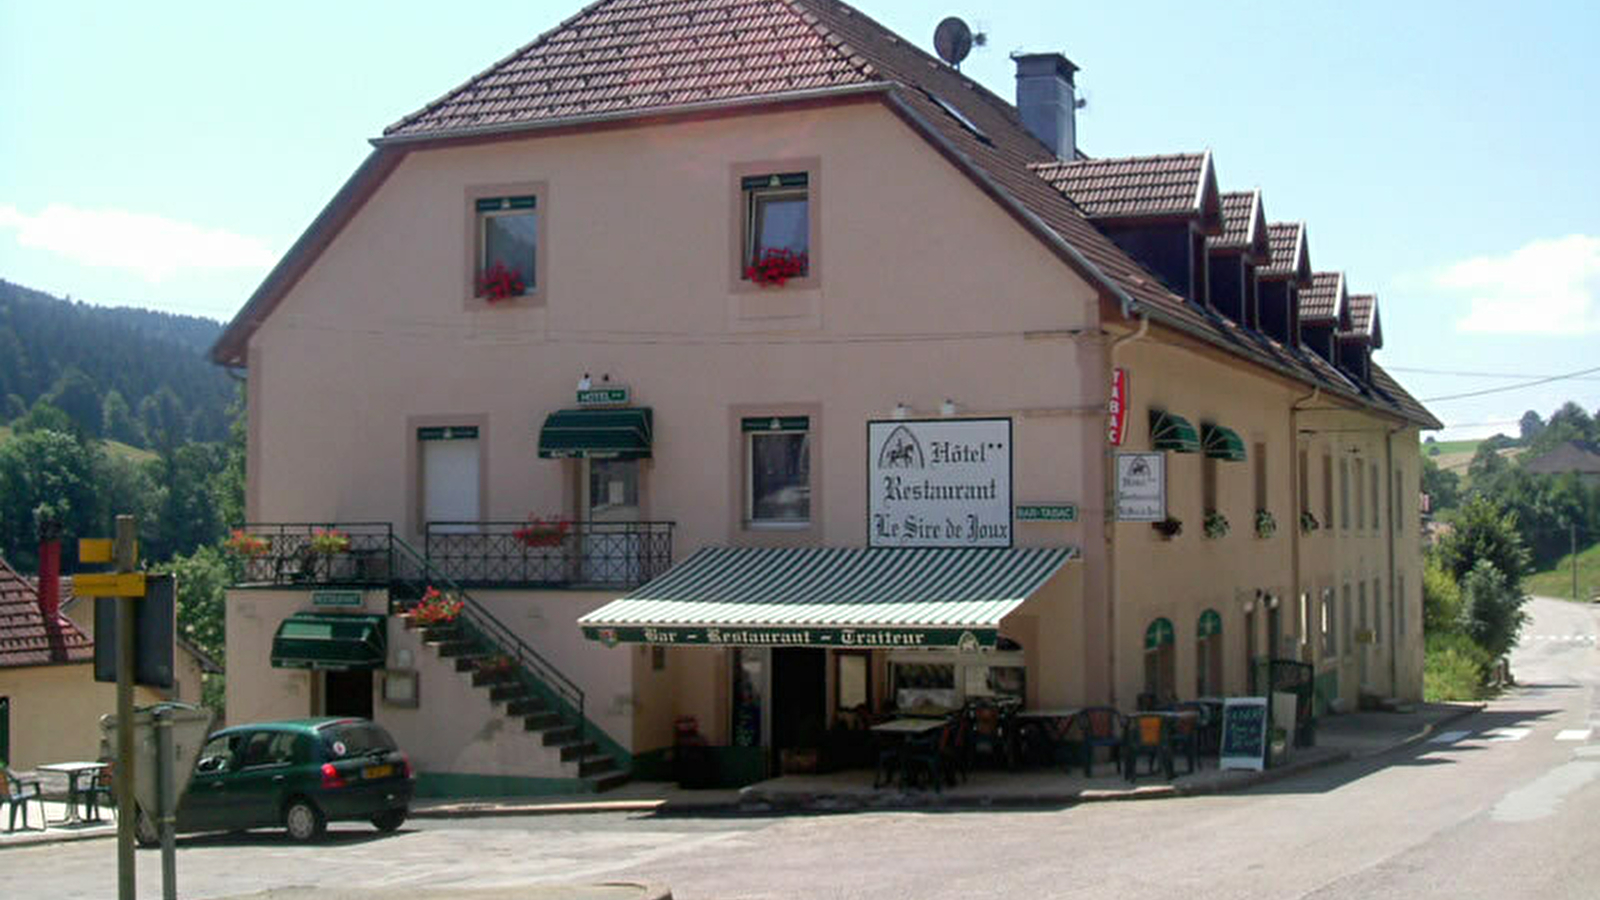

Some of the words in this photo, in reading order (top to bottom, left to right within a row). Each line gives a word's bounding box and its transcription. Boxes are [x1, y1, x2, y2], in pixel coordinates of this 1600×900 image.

[1109, 371, 1121, 443] TABAC
[931, 442, 986, 463] Hôtel
[884, 476, 996, 501] Restaurant
[1018, 508, 1072, 519] BAR-TABAC
[874, 514, 899, 538] Le
[902, 515, 940, 539] Sire
[945, 518, 963, 539] de
[966, 514, 1008, 543] Joux
[643, 627, 678, 643] Bar
[706, 627, 810, 643] Restaurant
[840, 629, 925, 645] Traiteur
